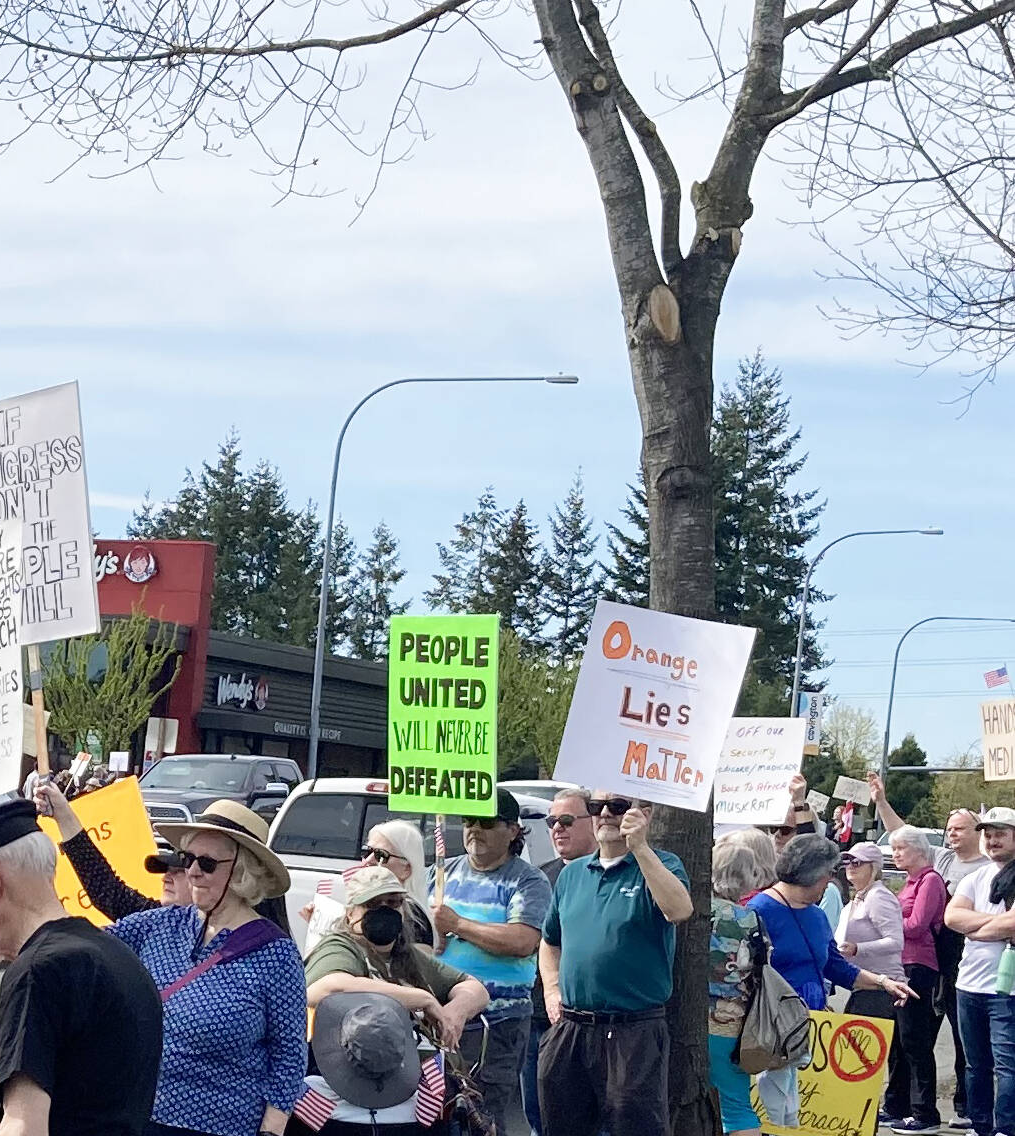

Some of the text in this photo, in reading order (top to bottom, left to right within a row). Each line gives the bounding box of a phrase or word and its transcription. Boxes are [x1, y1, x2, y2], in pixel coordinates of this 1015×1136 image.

[31, 519, 59, 545] THE
[22, 540, 80, 587] PLE
[21, 580, 73, 626] ILL
[399, 632, 490, 668] PEOPLE
[602, 621, 698, 681] Orange
[217, 672, 254, 709] Wendy's
[399, 677, 486, 710] UNITED
[619, 686, 691, 727] Lies
[736, 725, 785, 739] OFF OUR
[808, 696, 819, 741] covington
[982, 703, 1015, 735] HAND
[393, 719, 490, 755] WILL NEVER BE
[390, 765, 493, 801] DEFEATED
[715, 798, 774, 813] MUSKRAT
